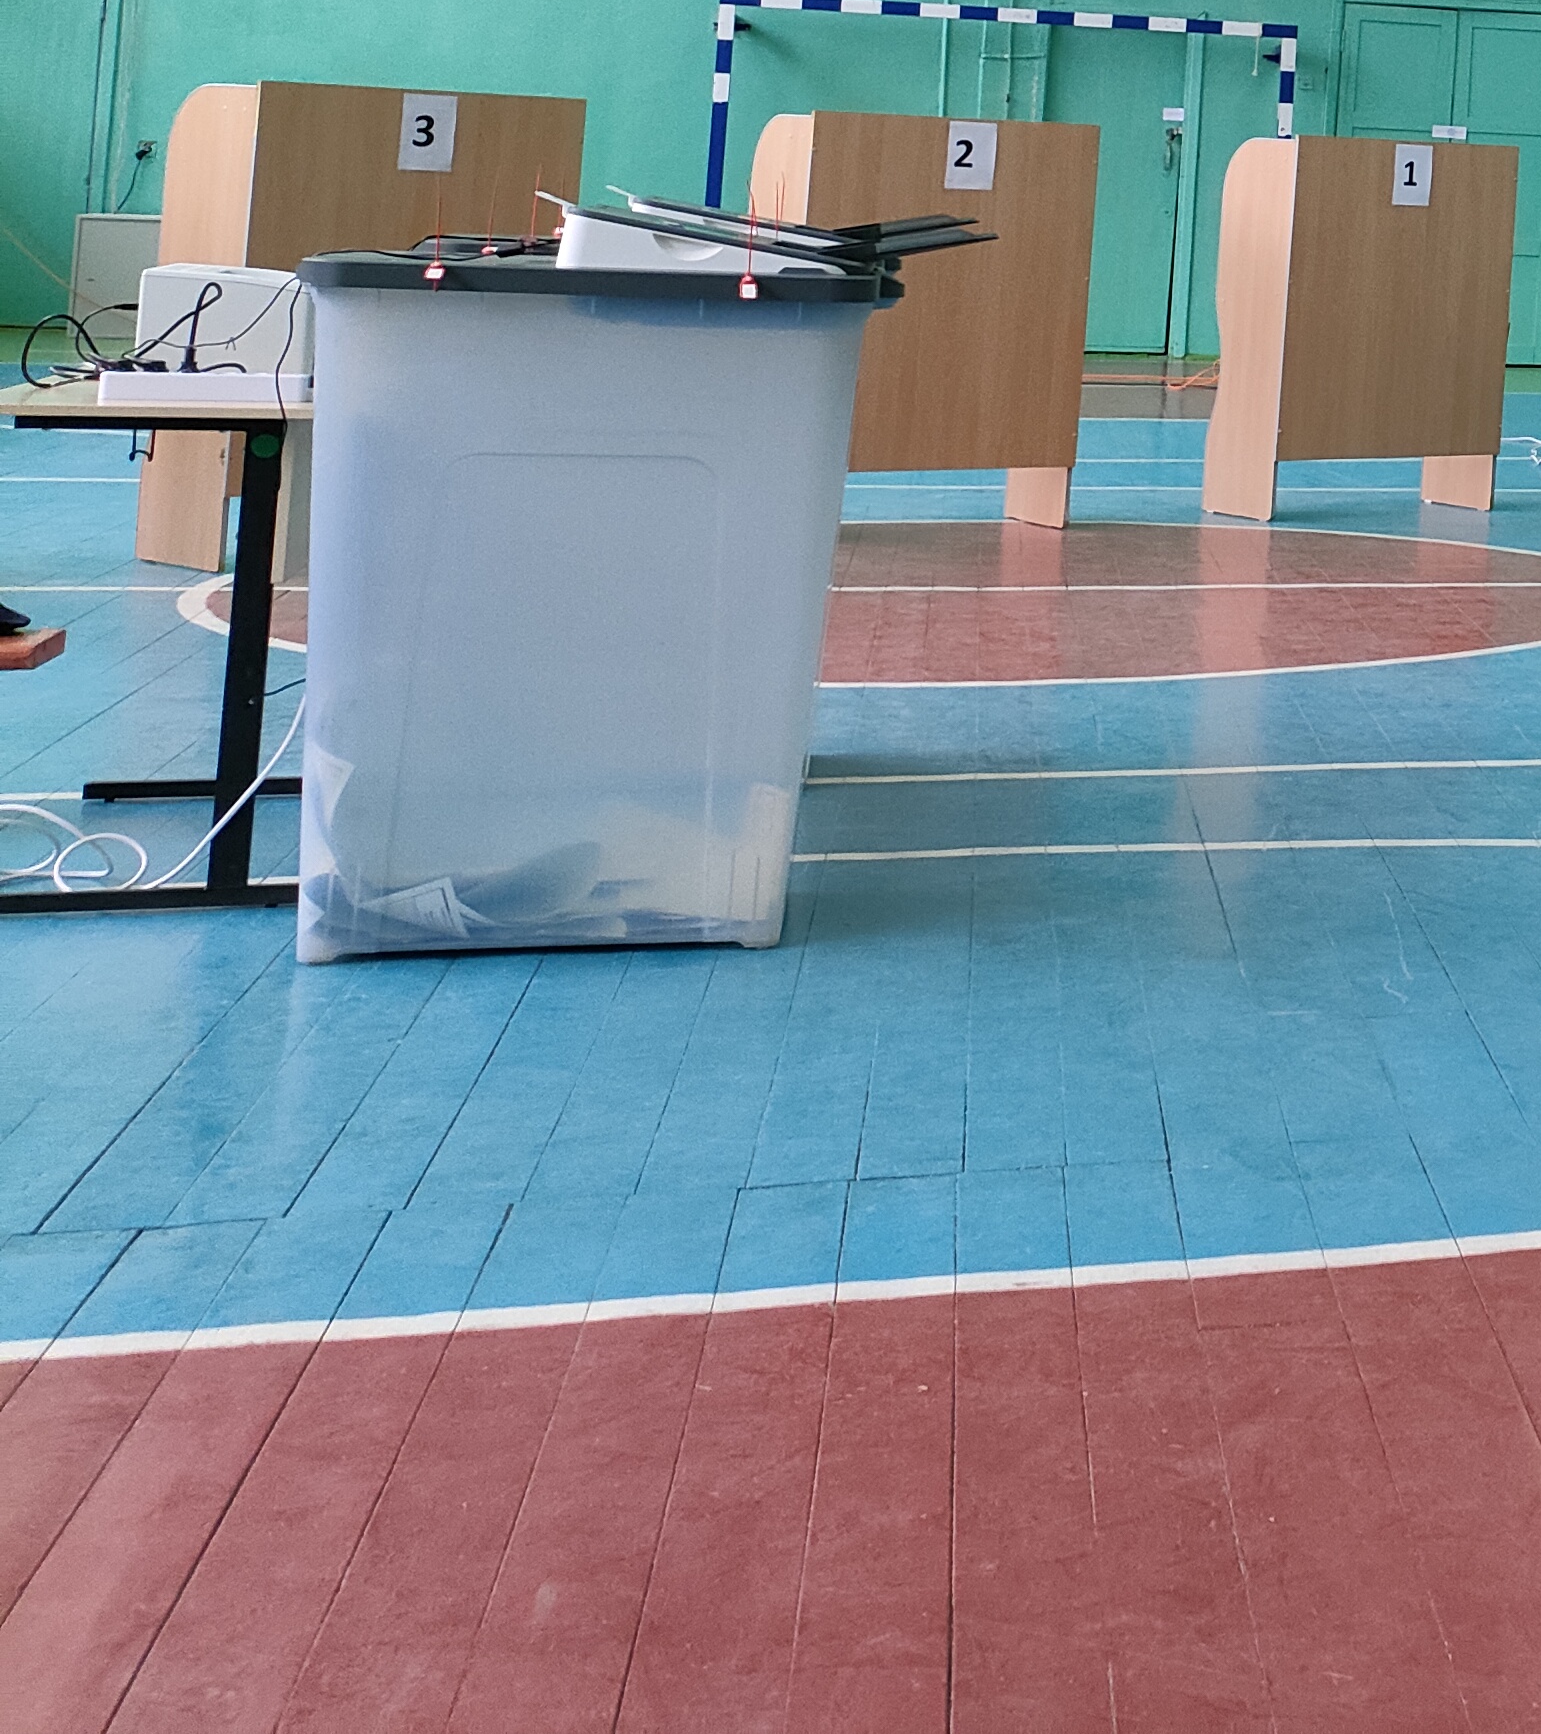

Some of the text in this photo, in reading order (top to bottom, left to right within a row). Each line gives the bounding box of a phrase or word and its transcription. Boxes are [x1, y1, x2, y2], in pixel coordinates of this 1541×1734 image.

[412, 114, 435, 147] 3
[954, 139, 973, 168] 2
[1403, 160, 1418, 187] 1
